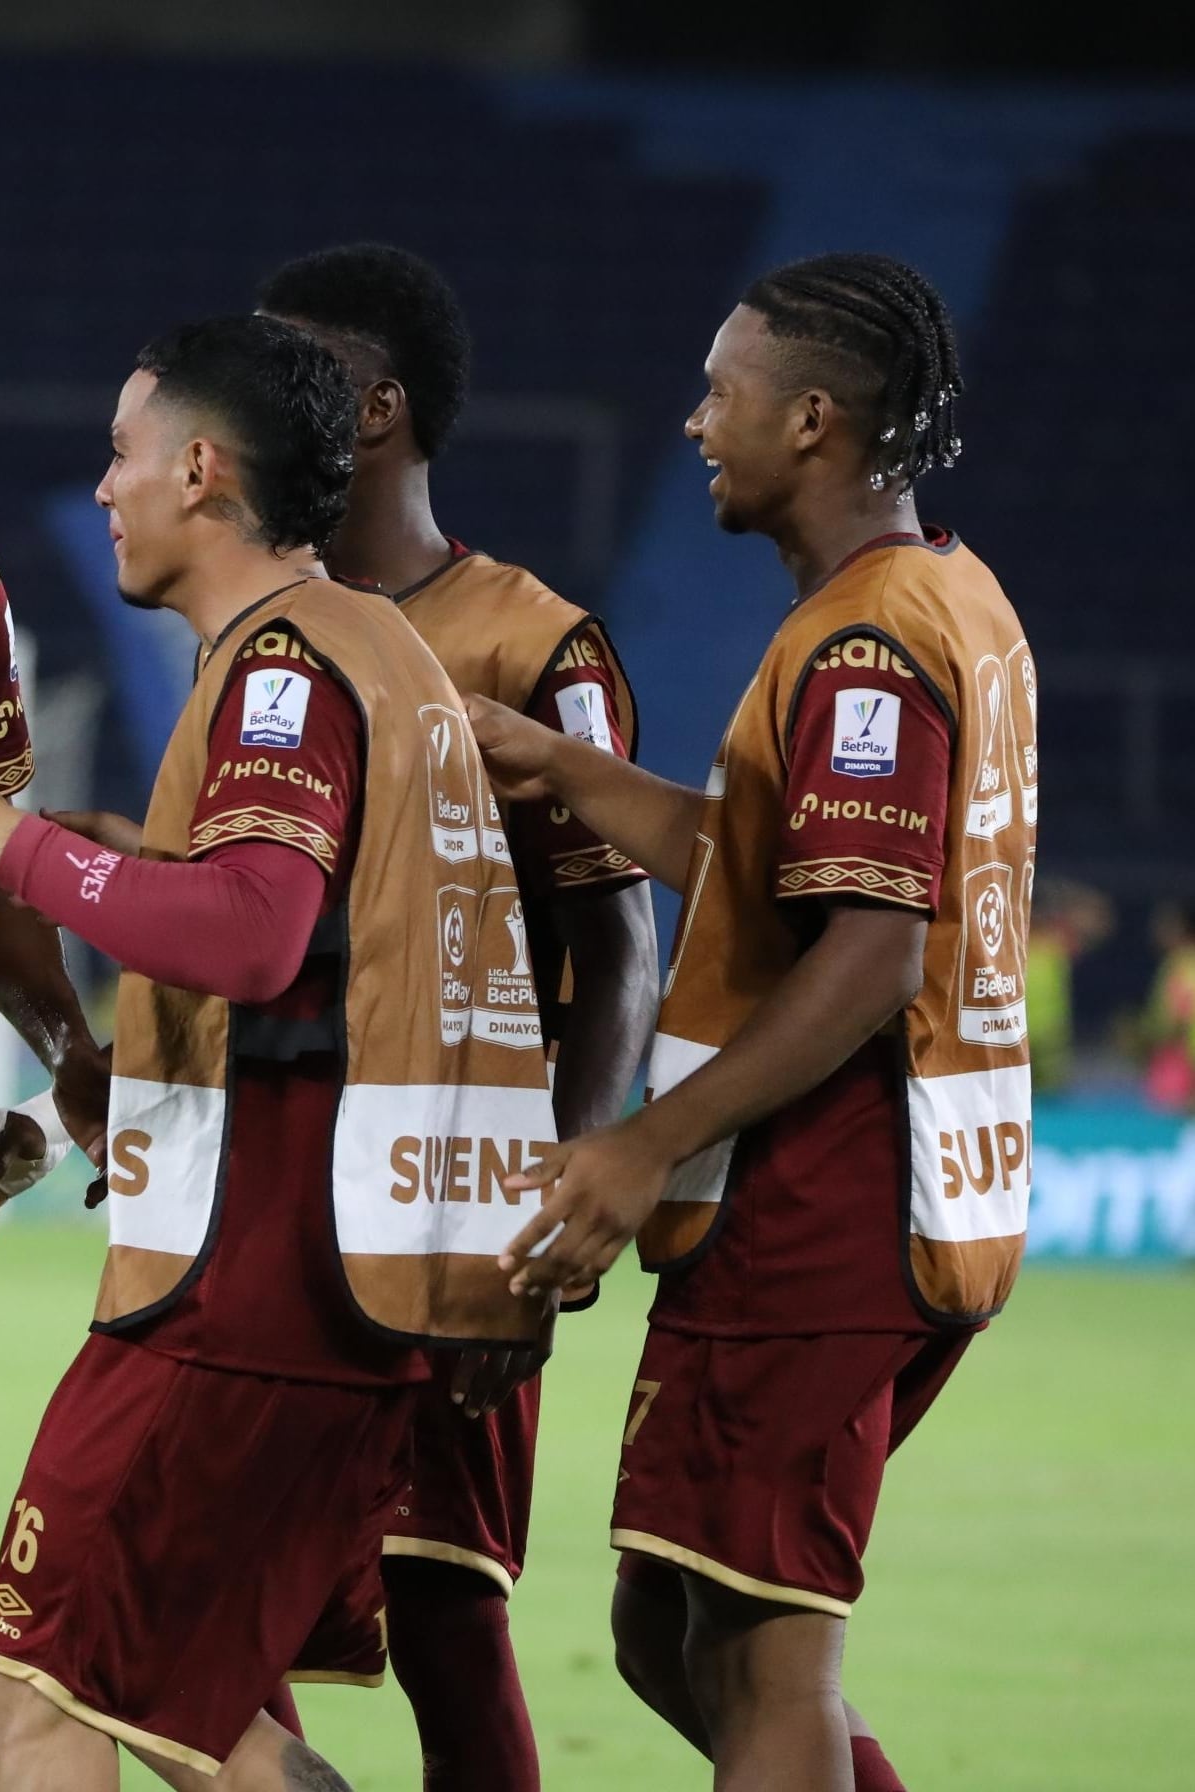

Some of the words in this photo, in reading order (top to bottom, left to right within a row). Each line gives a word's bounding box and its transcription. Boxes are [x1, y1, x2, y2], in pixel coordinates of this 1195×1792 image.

[249, 714, 296, 730] BetPlay
[840, 741, 888, 756] BetPlay
[844, 762, 881, 772] DIMAYOR
[234, 757, 334, 801] HOLCIM
[822, 799, 929, 835] HOLCIM
[65, 851, 90, 870] 7
[79, 849, 122, 904] REYES
[488, 968, 509, 977] LIGA
[488, 977, 532, 987] FEMENINA
[489, 1021, 542, 1036] DIMAYO
[1, 1498, 45, 1574] 16
